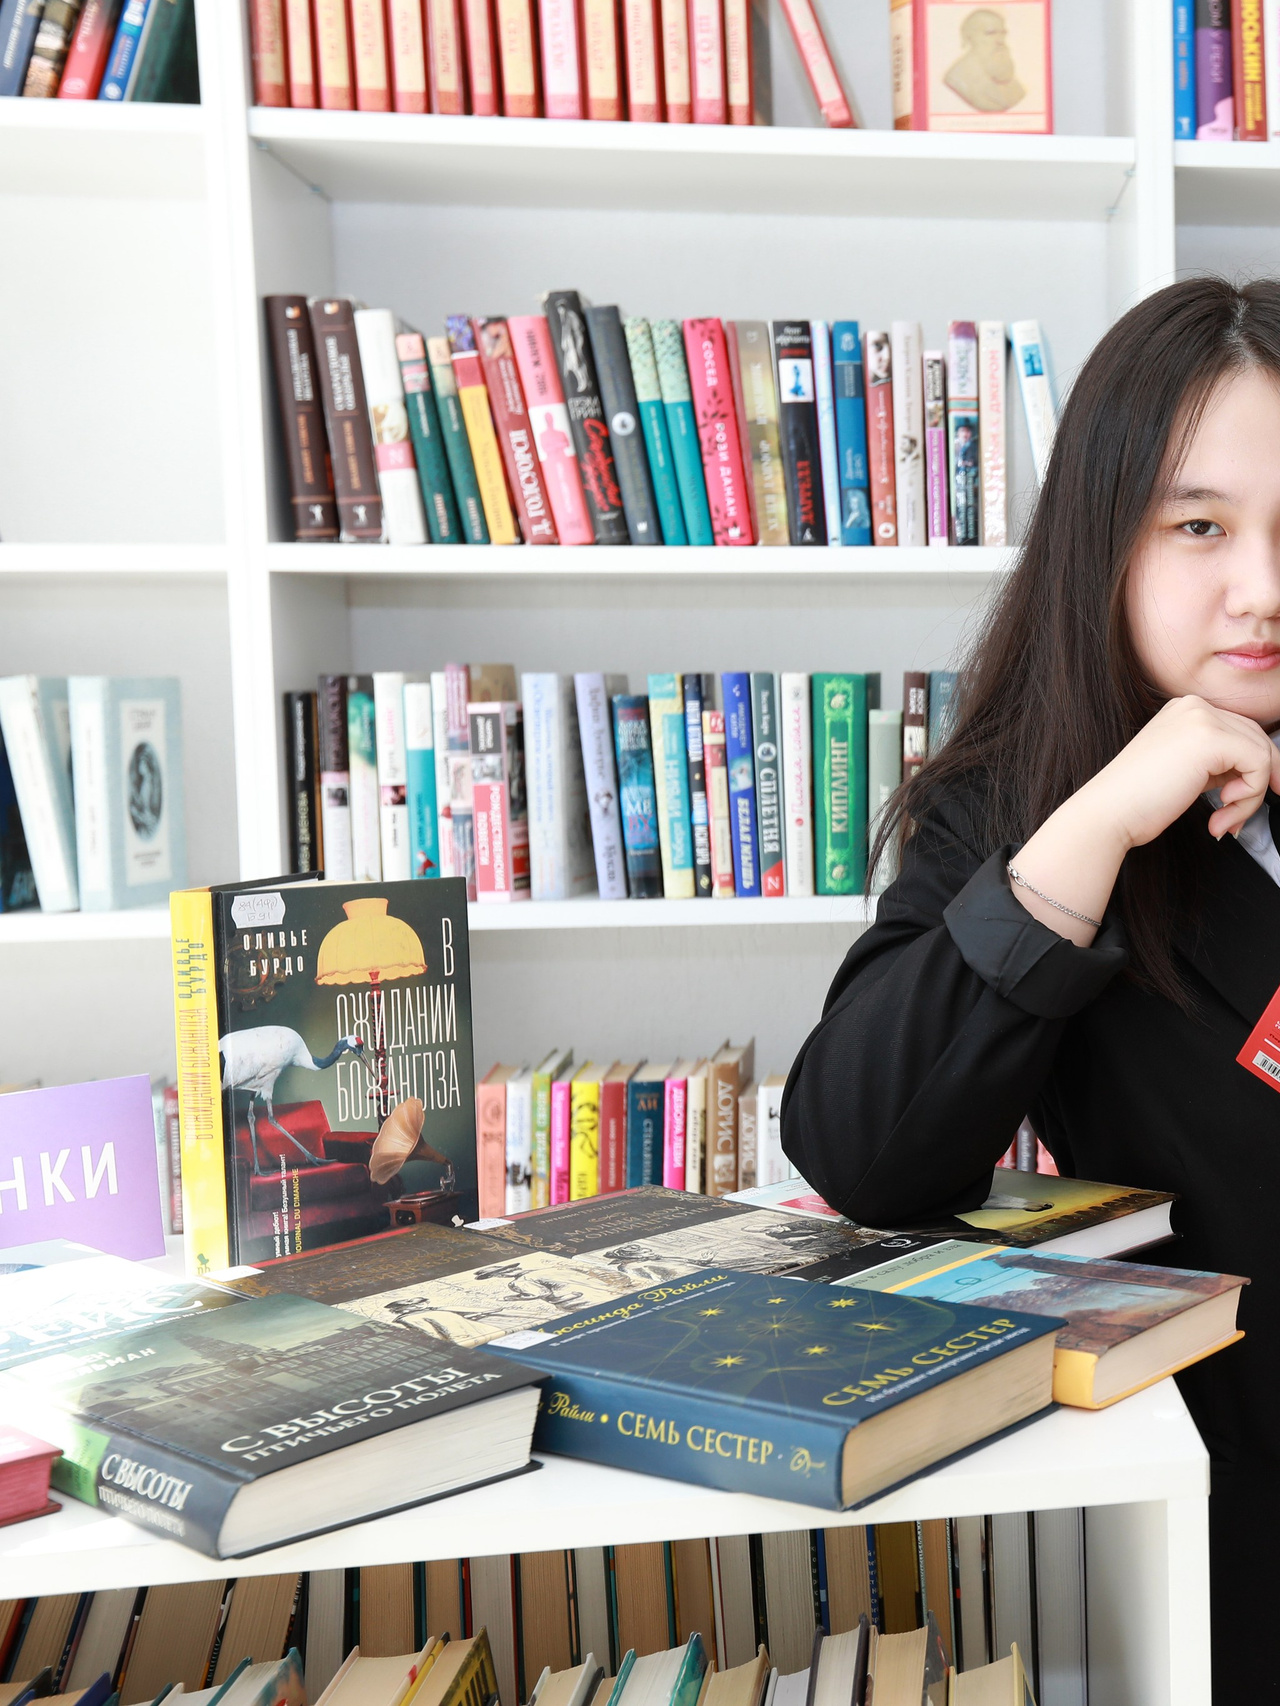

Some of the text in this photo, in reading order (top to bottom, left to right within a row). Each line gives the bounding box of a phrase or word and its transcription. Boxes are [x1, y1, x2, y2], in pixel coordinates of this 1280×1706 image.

[701, 340, 736, 517] СОСЕД РОЗИ ДАНАН
[759, 767, 780, 854] СПЛЕТНЯ
[831, 737, 849, 834] КИПЛИНГ
[737, 797, 754, 889] БЕЛАЯ МЫШЬ
[175, 937, 192, 999] ОЛИВЬЕ
[190, 942, 208, 994] БУРДО
[243, 929, 309, 952] ОЛИВЬЕ
[250, 955, 305, 978] БУРДО
[441, 917, 456, 978] В
[336, 983, 458, 1056] ОЖИДАНИИ
[336, 1048, 461, 1123] БОЖАНГЛЗА
[717, 1080, 734, 1152] ДОРИС
[742, 1113, 755, 1169] ДОРИС
[291, 1168, 301, 1207] DIMANCHE
[292, 1208, 301, 1220] DU
[637, 1273, 729, 1303] Райли
[822, 1318, 1017, 1406] СЕМЬ СЕСТЕР
[221, 1366, 471, 1454] С ВЫСОТЫ
[242, 1372, 503, 1462] ПТИЧЬЕГО ПОЛЕТА
[616, 1410, 681, 1449] СЕМЬ
[686, 1425, 775, 1466] СЕСТЕР
[101, 1454, 194, 1512] С ВЫСОТЫ
